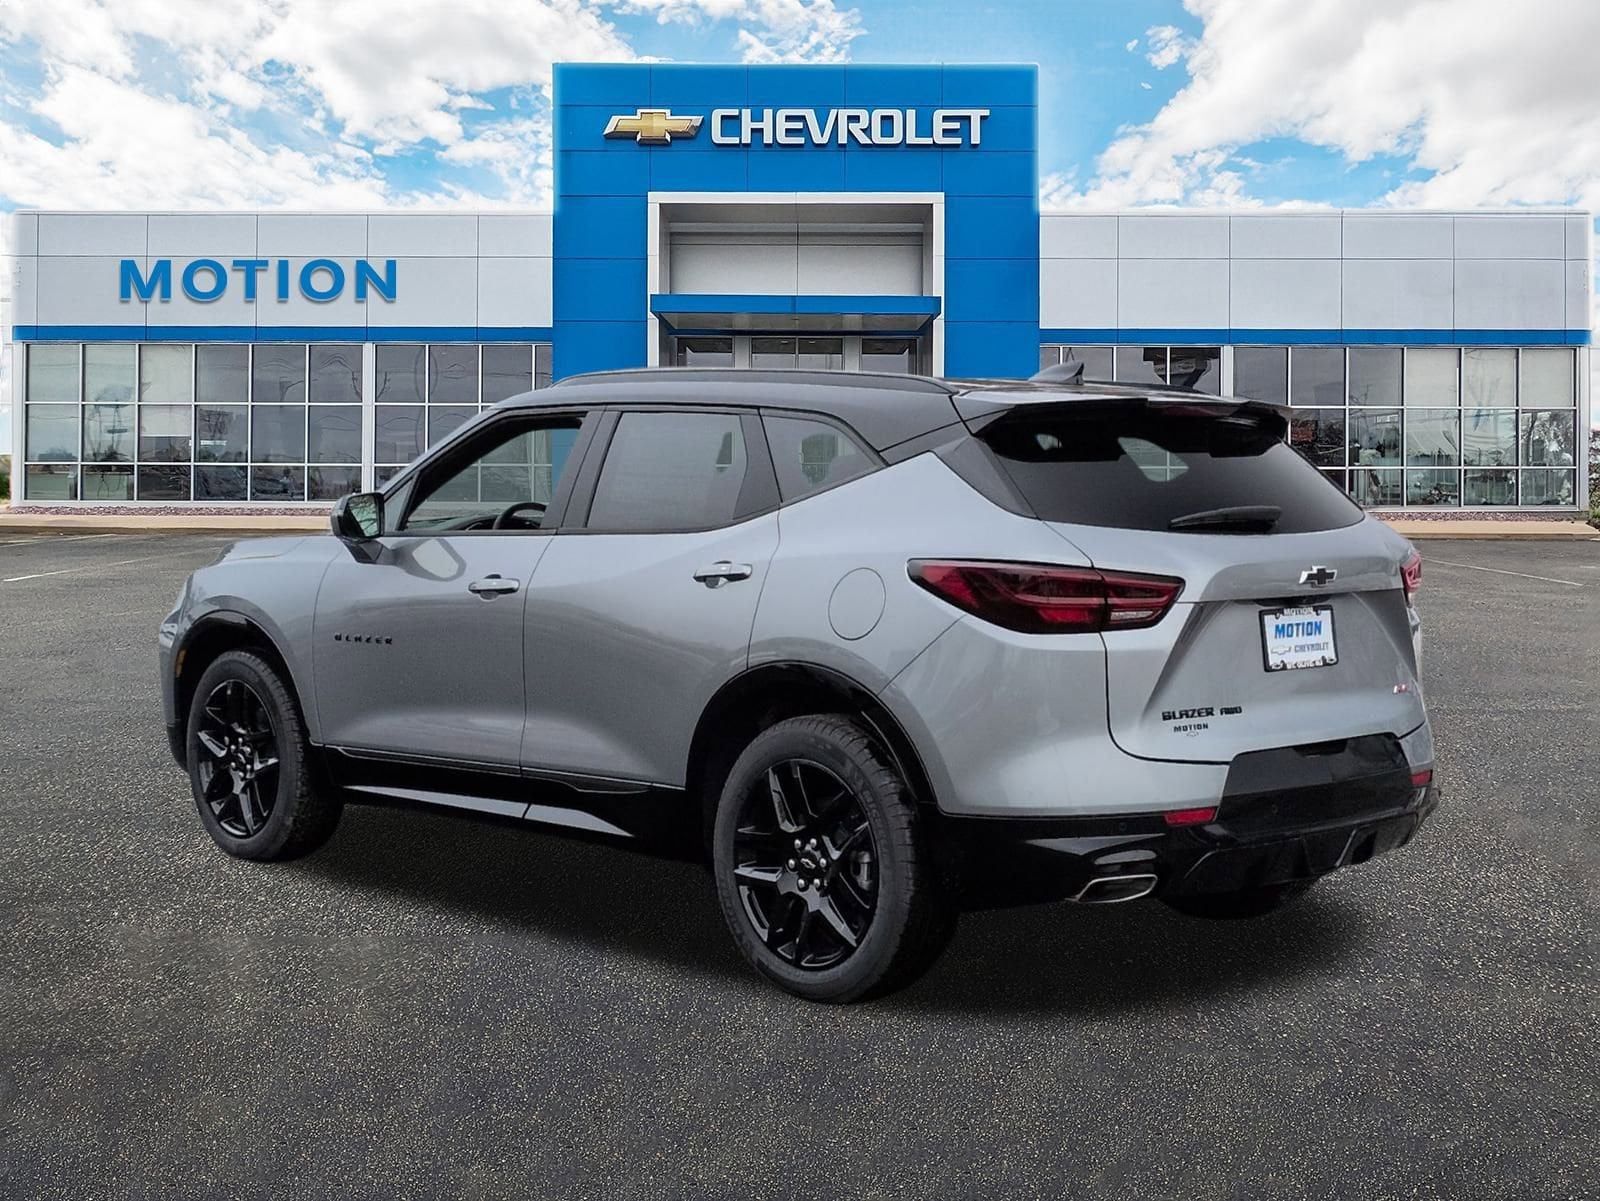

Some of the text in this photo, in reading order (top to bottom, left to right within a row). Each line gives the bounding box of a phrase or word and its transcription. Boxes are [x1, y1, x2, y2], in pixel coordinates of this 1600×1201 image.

[711, 108, 990, 145] CHEVROLET
[119, 258, 397, 302] MOTION
[1274, 620, 1322, 640] MOTION
[1294, 642, 1329, 653] CHEVROLET
[1162, 706, 1215, 721] BLAZER
[1173, 723, 1209, 733] MOTION
